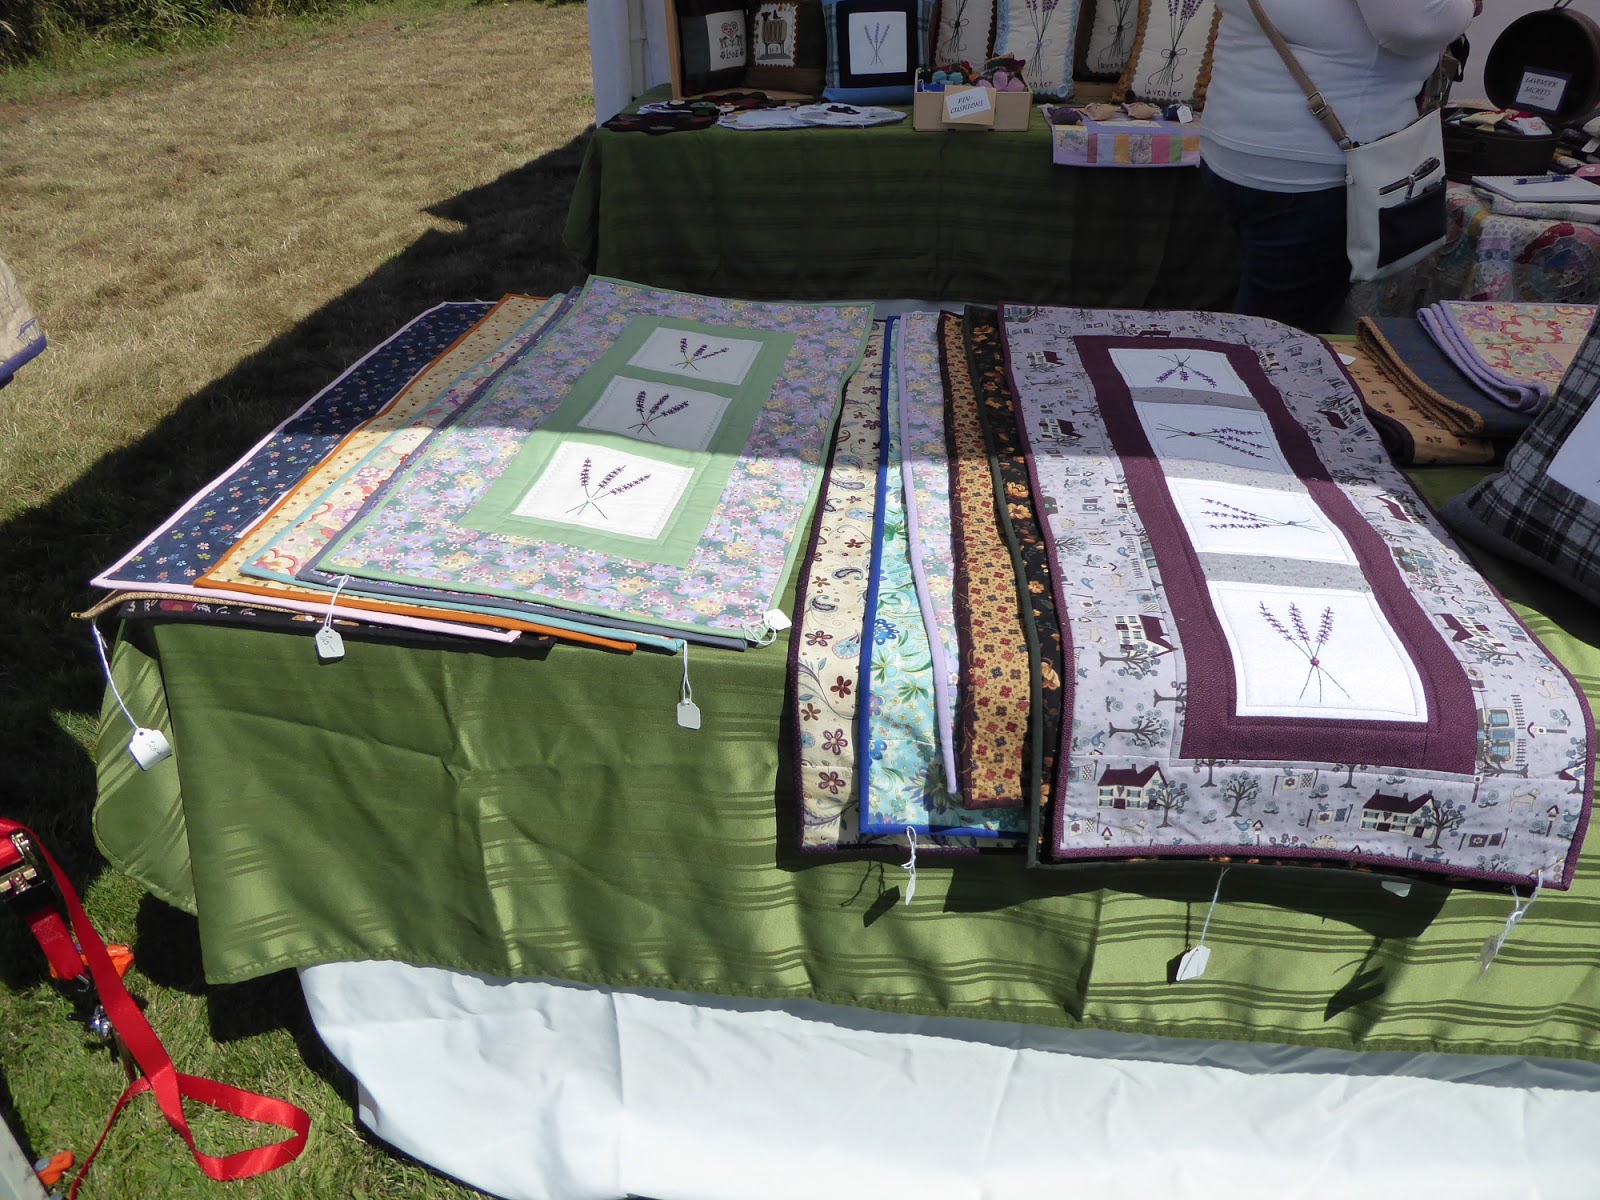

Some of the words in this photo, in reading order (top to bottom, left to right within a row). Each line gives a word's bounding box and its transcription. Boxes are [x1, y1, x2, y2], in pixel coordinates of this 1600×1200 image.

[1525, 76, 1559, 88] LAVENDER
[1144, 84, 1182, 98] lavender
[950, 100, 984, 114] CUSHIONS
